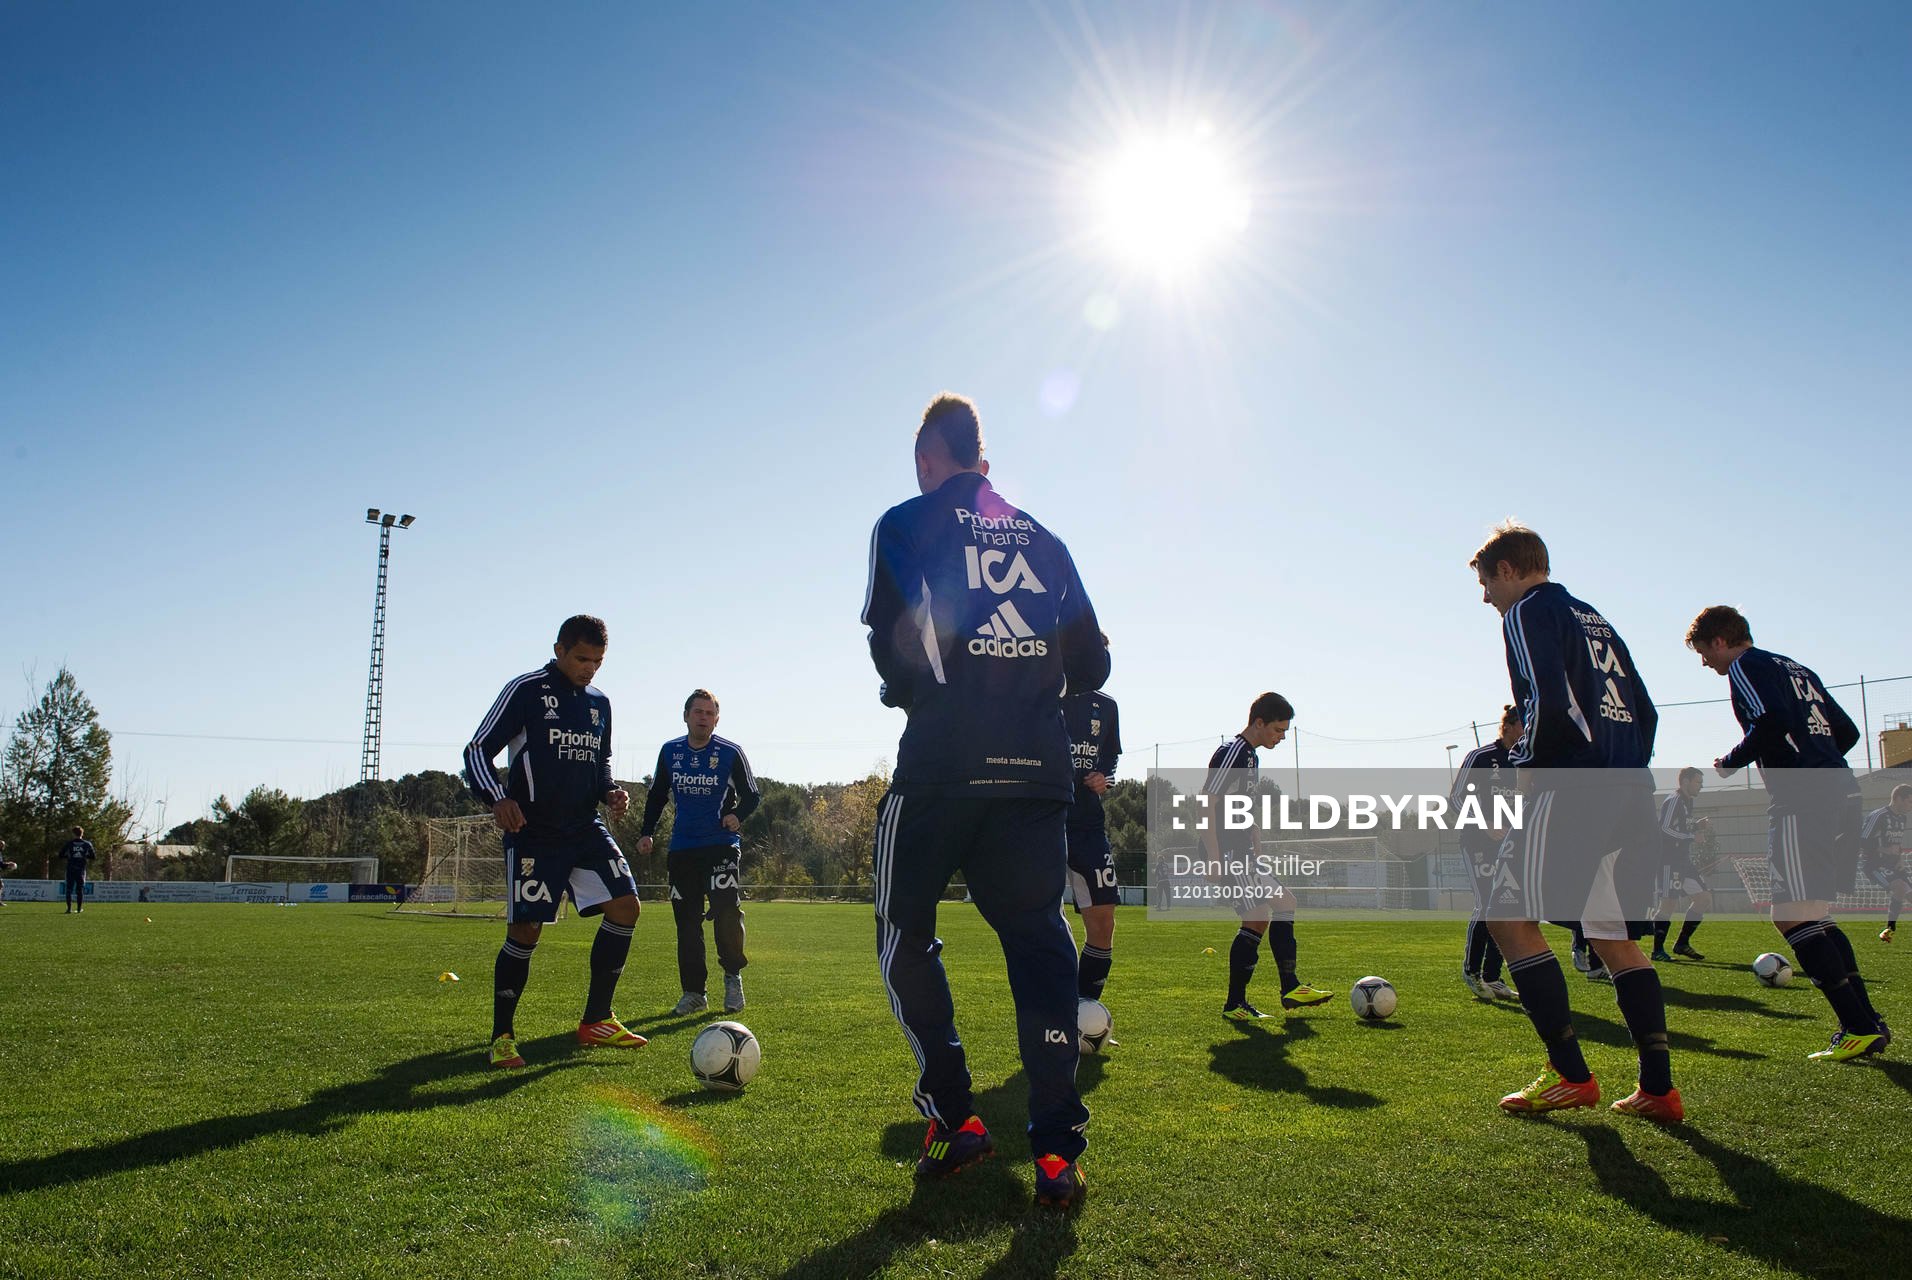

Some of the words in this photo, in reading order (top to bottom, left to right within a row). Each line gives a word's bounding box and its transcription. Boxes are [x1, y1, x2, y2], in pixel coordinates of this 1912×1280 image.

[954, 507, 1037, 533] Prioritet
[971, 525, 1031, 546] Finans
[964, 545, 1048, 595] ICA
[967, 635, 1048, 659] adidas
[1586, 636, 1626, 678] ICA
[540, 694, 559, 709] 10
[1790, 675, 1825, 704] ICA
[672, 771, 720, 786] Prioritet
[676, 783, 712, 796] Finans
[514, 879, 553, 903] ICA
[710, 873, 739, 891] ICA
